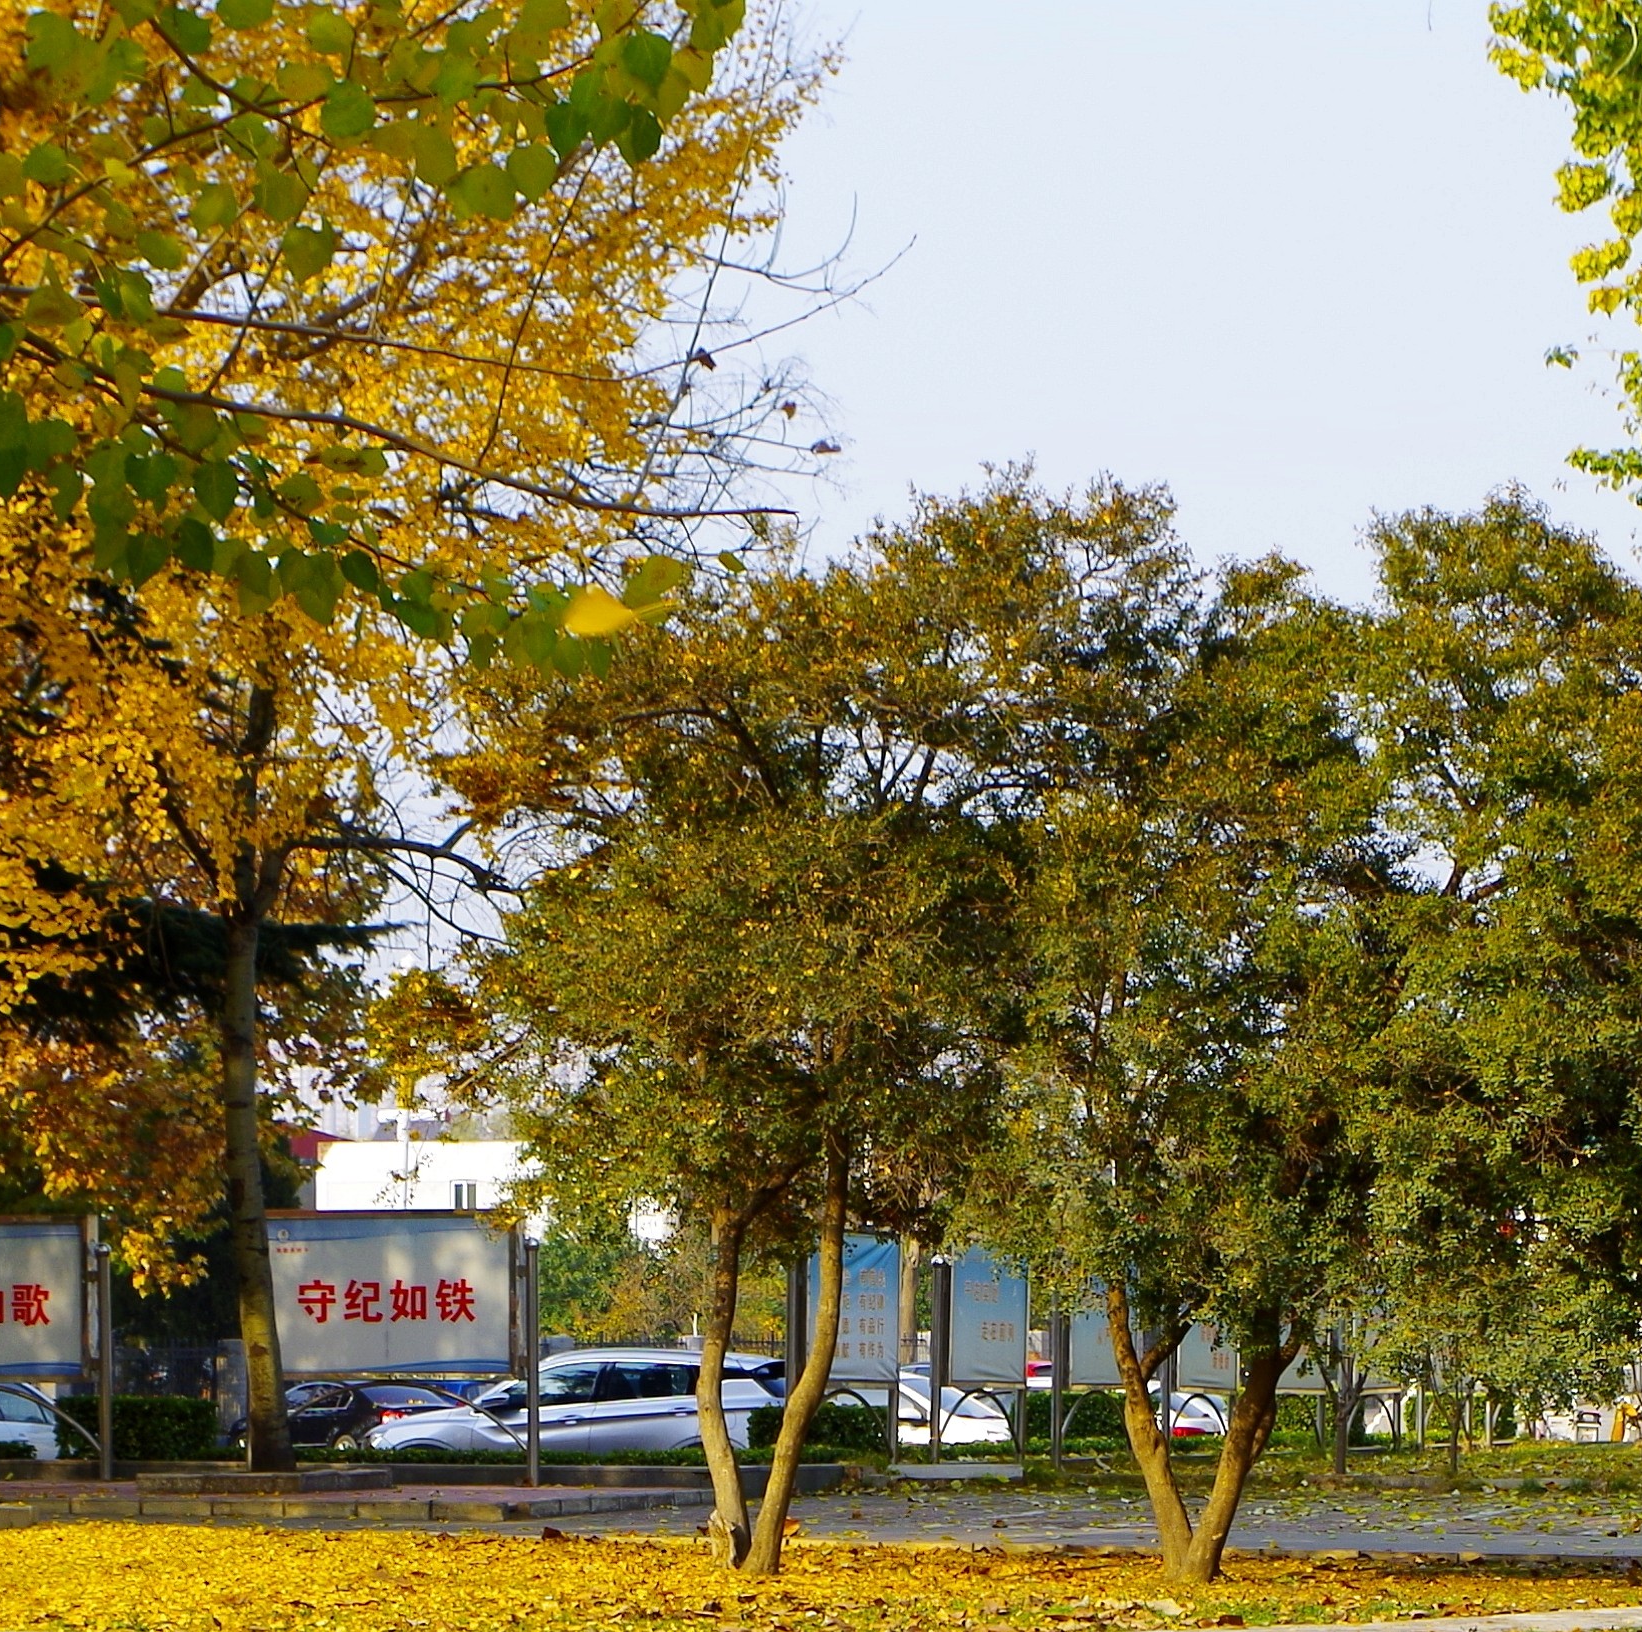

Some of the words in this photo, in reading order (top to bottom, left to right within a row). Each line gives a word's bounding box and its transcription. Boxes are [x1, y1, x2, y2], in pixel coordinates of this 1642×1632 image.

[297, 1278, 477, 1324] 守纪如铁
[858, 1318, 885, 1336] 有品行
[858, 1342, 885, 1360] 有作为
